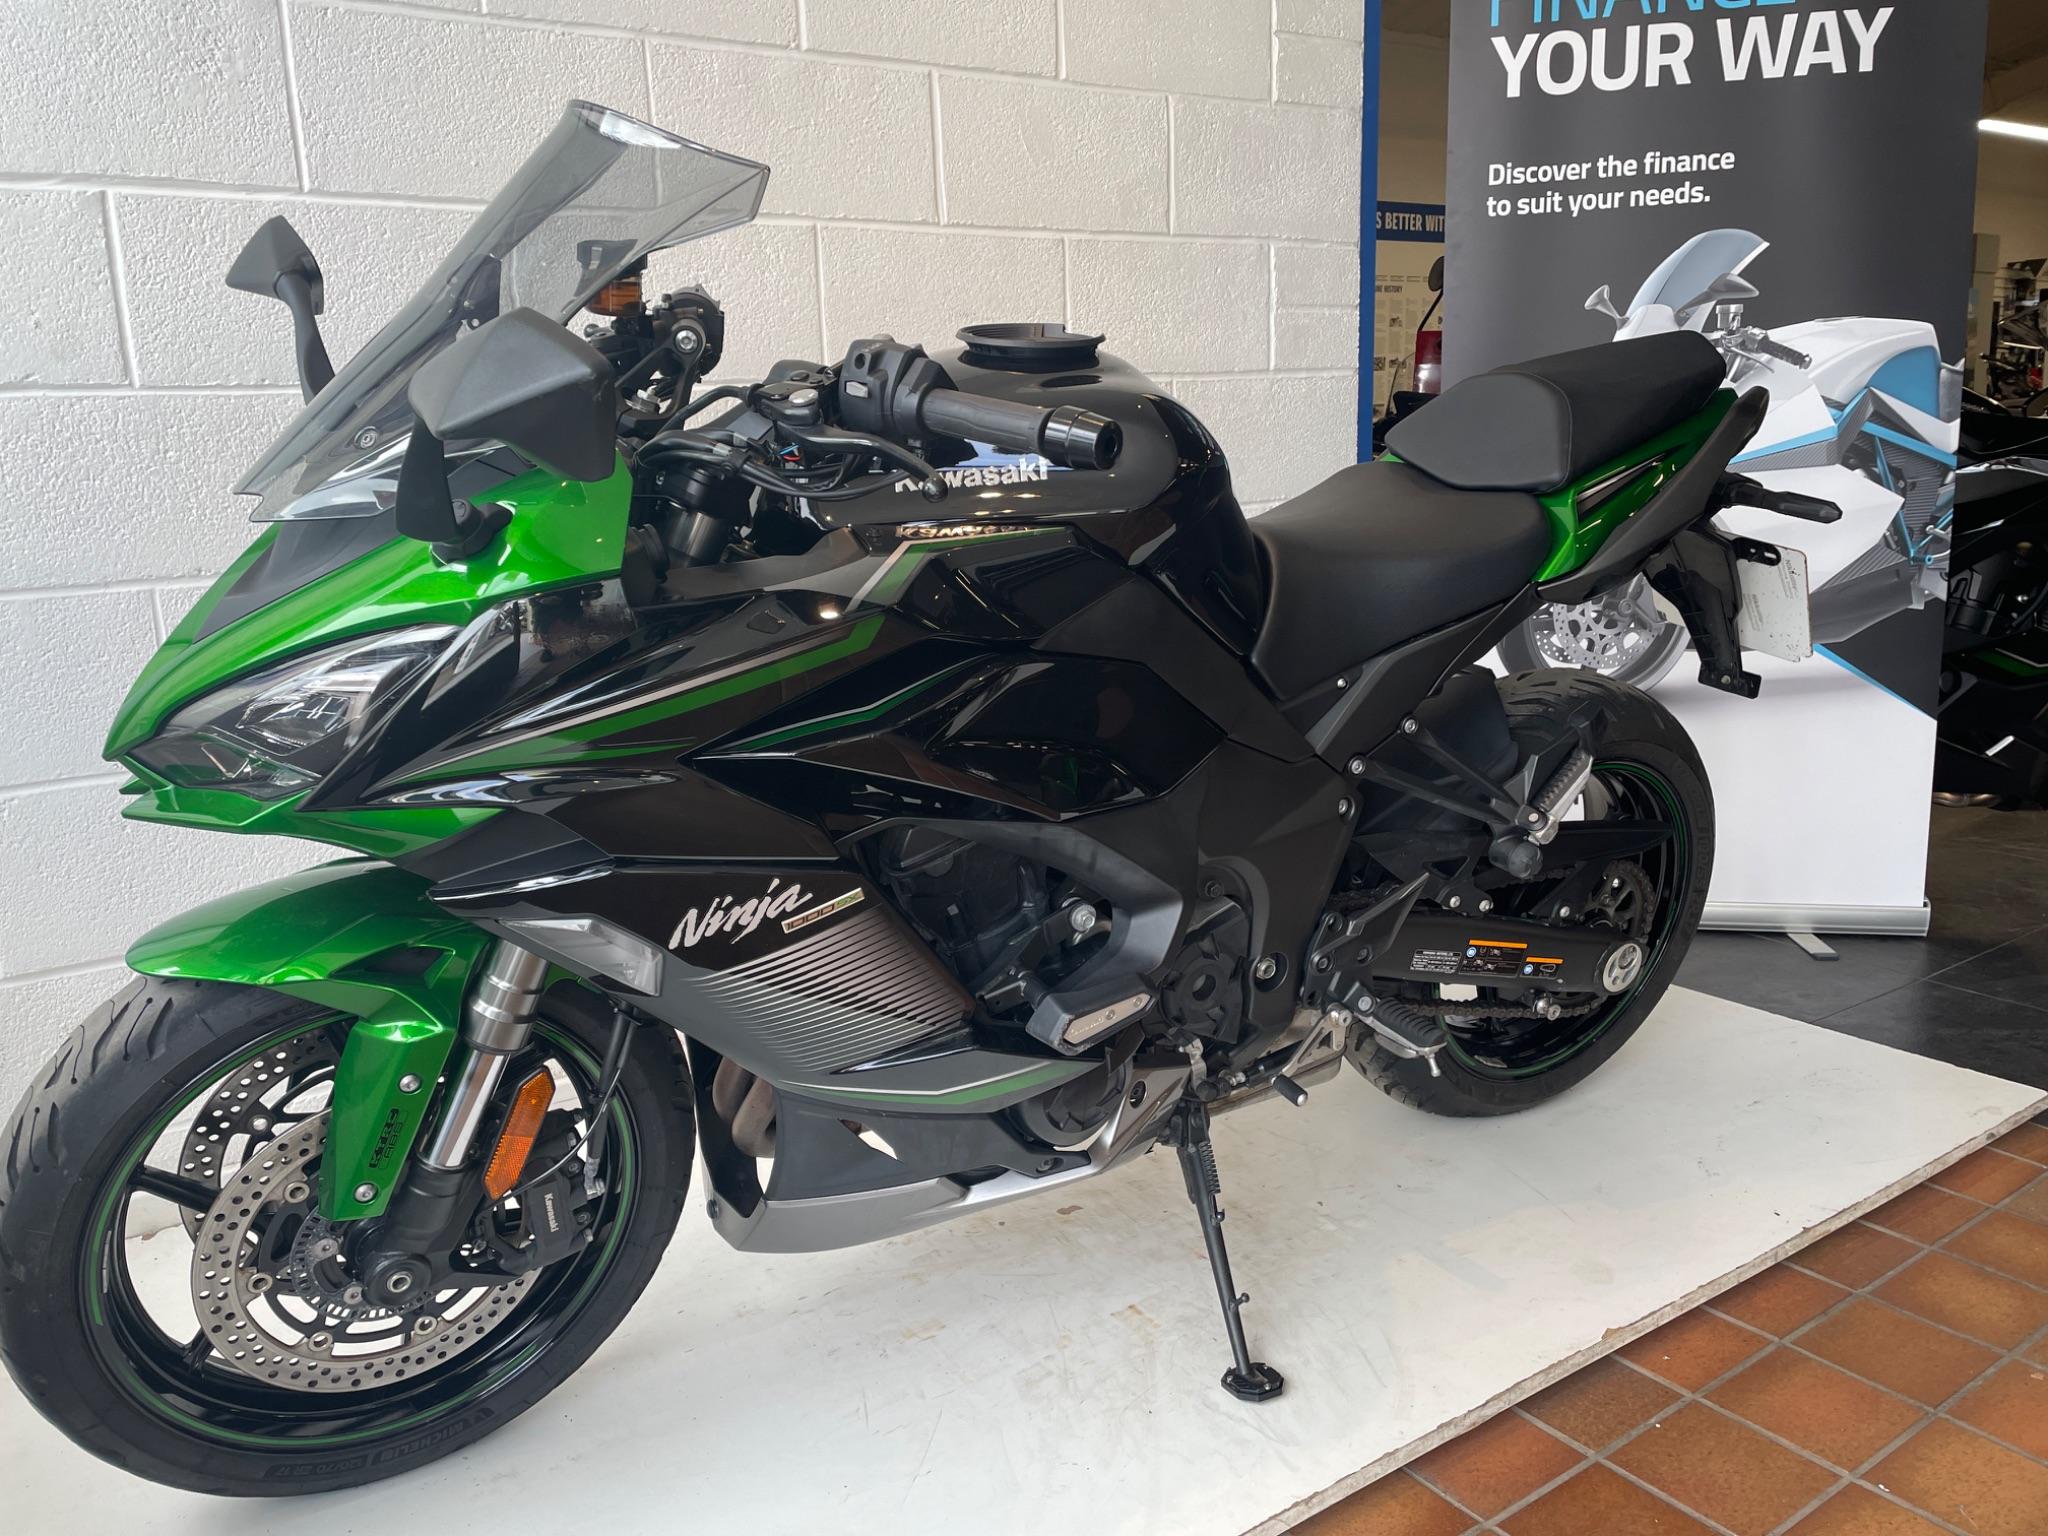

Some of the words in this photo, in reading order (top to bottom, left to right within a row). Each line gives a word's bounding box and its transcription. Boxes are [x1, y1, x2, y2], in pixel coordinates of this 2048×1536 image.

[1490, 29, 1694, 98] YOUR
[1716, 7, 1895, 82] WAY
[1488, 157, 1590, 187] Discover
[1597, 154, 1638, 179] the
[1644, 150, 1735, 176] finance
[1486, 193, 1511, 217] to
[1517, 186, 1562, 215] suit
[1569, 189, 1623, 220] your
[1629, 180, 1711, 207] needs.
[1385, 212, 1422, 231] BETTER
[1425, 214, 1445, 232] WIT
[895, 456, 1048, 493] Kwasaki
[668, 878, 813, 950] Ninja
[543, 1192, 560, 1233] Kawasaki
[381, 1421, 464, 1462] MICHELIN
